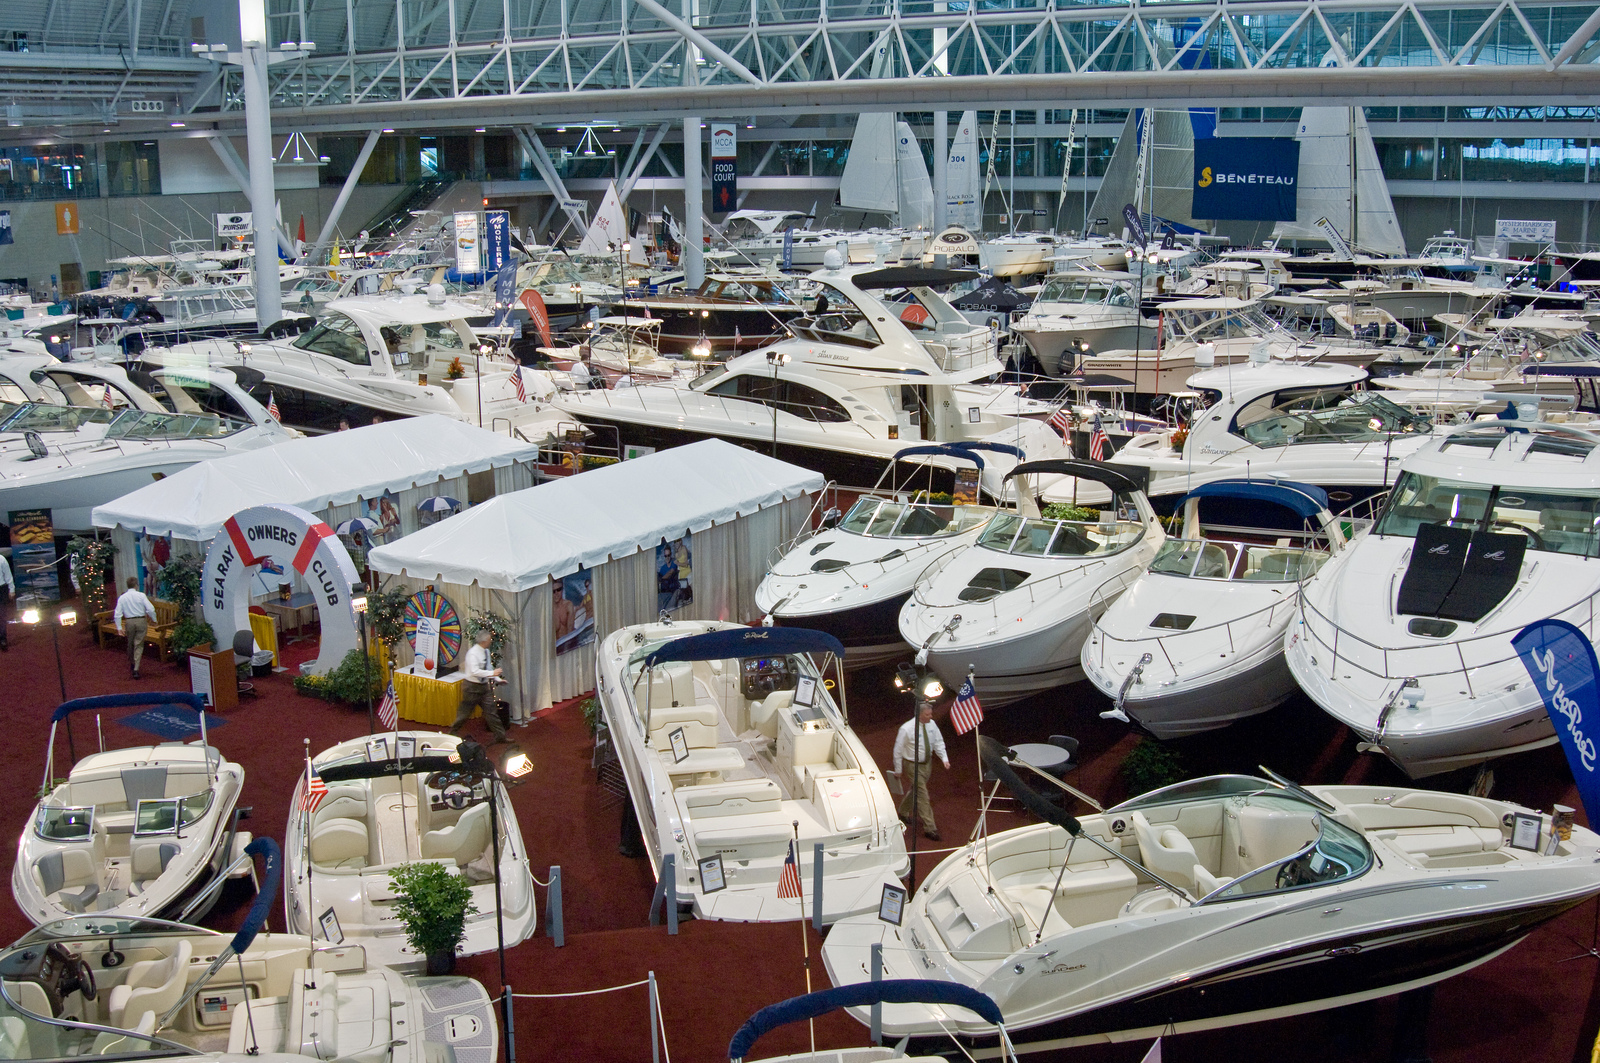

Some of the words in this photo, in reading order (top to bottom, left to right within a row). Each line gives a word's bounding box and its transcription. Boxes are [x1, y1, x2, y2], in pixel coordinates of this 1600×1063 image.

[714, 138, 733, 147] MCCA
[950, 155, 966, 163] 304
[715, 164, 734, 172] FOOD
[713, 173, 736, 182] COURT
[222, 223, 249, 231] PURSUIT
[494, 224, 503, 269] MONTEREY
[959, 303, 998, 311] ROBALO
[247, 524, 298, 546] OWNERS
[216, 545, 235, 577] RAY
[312, 559, 339, 607] CLUB
[213, 577, 225, 610] SEA
[1041, 964, 1087, 975] SunDeck
